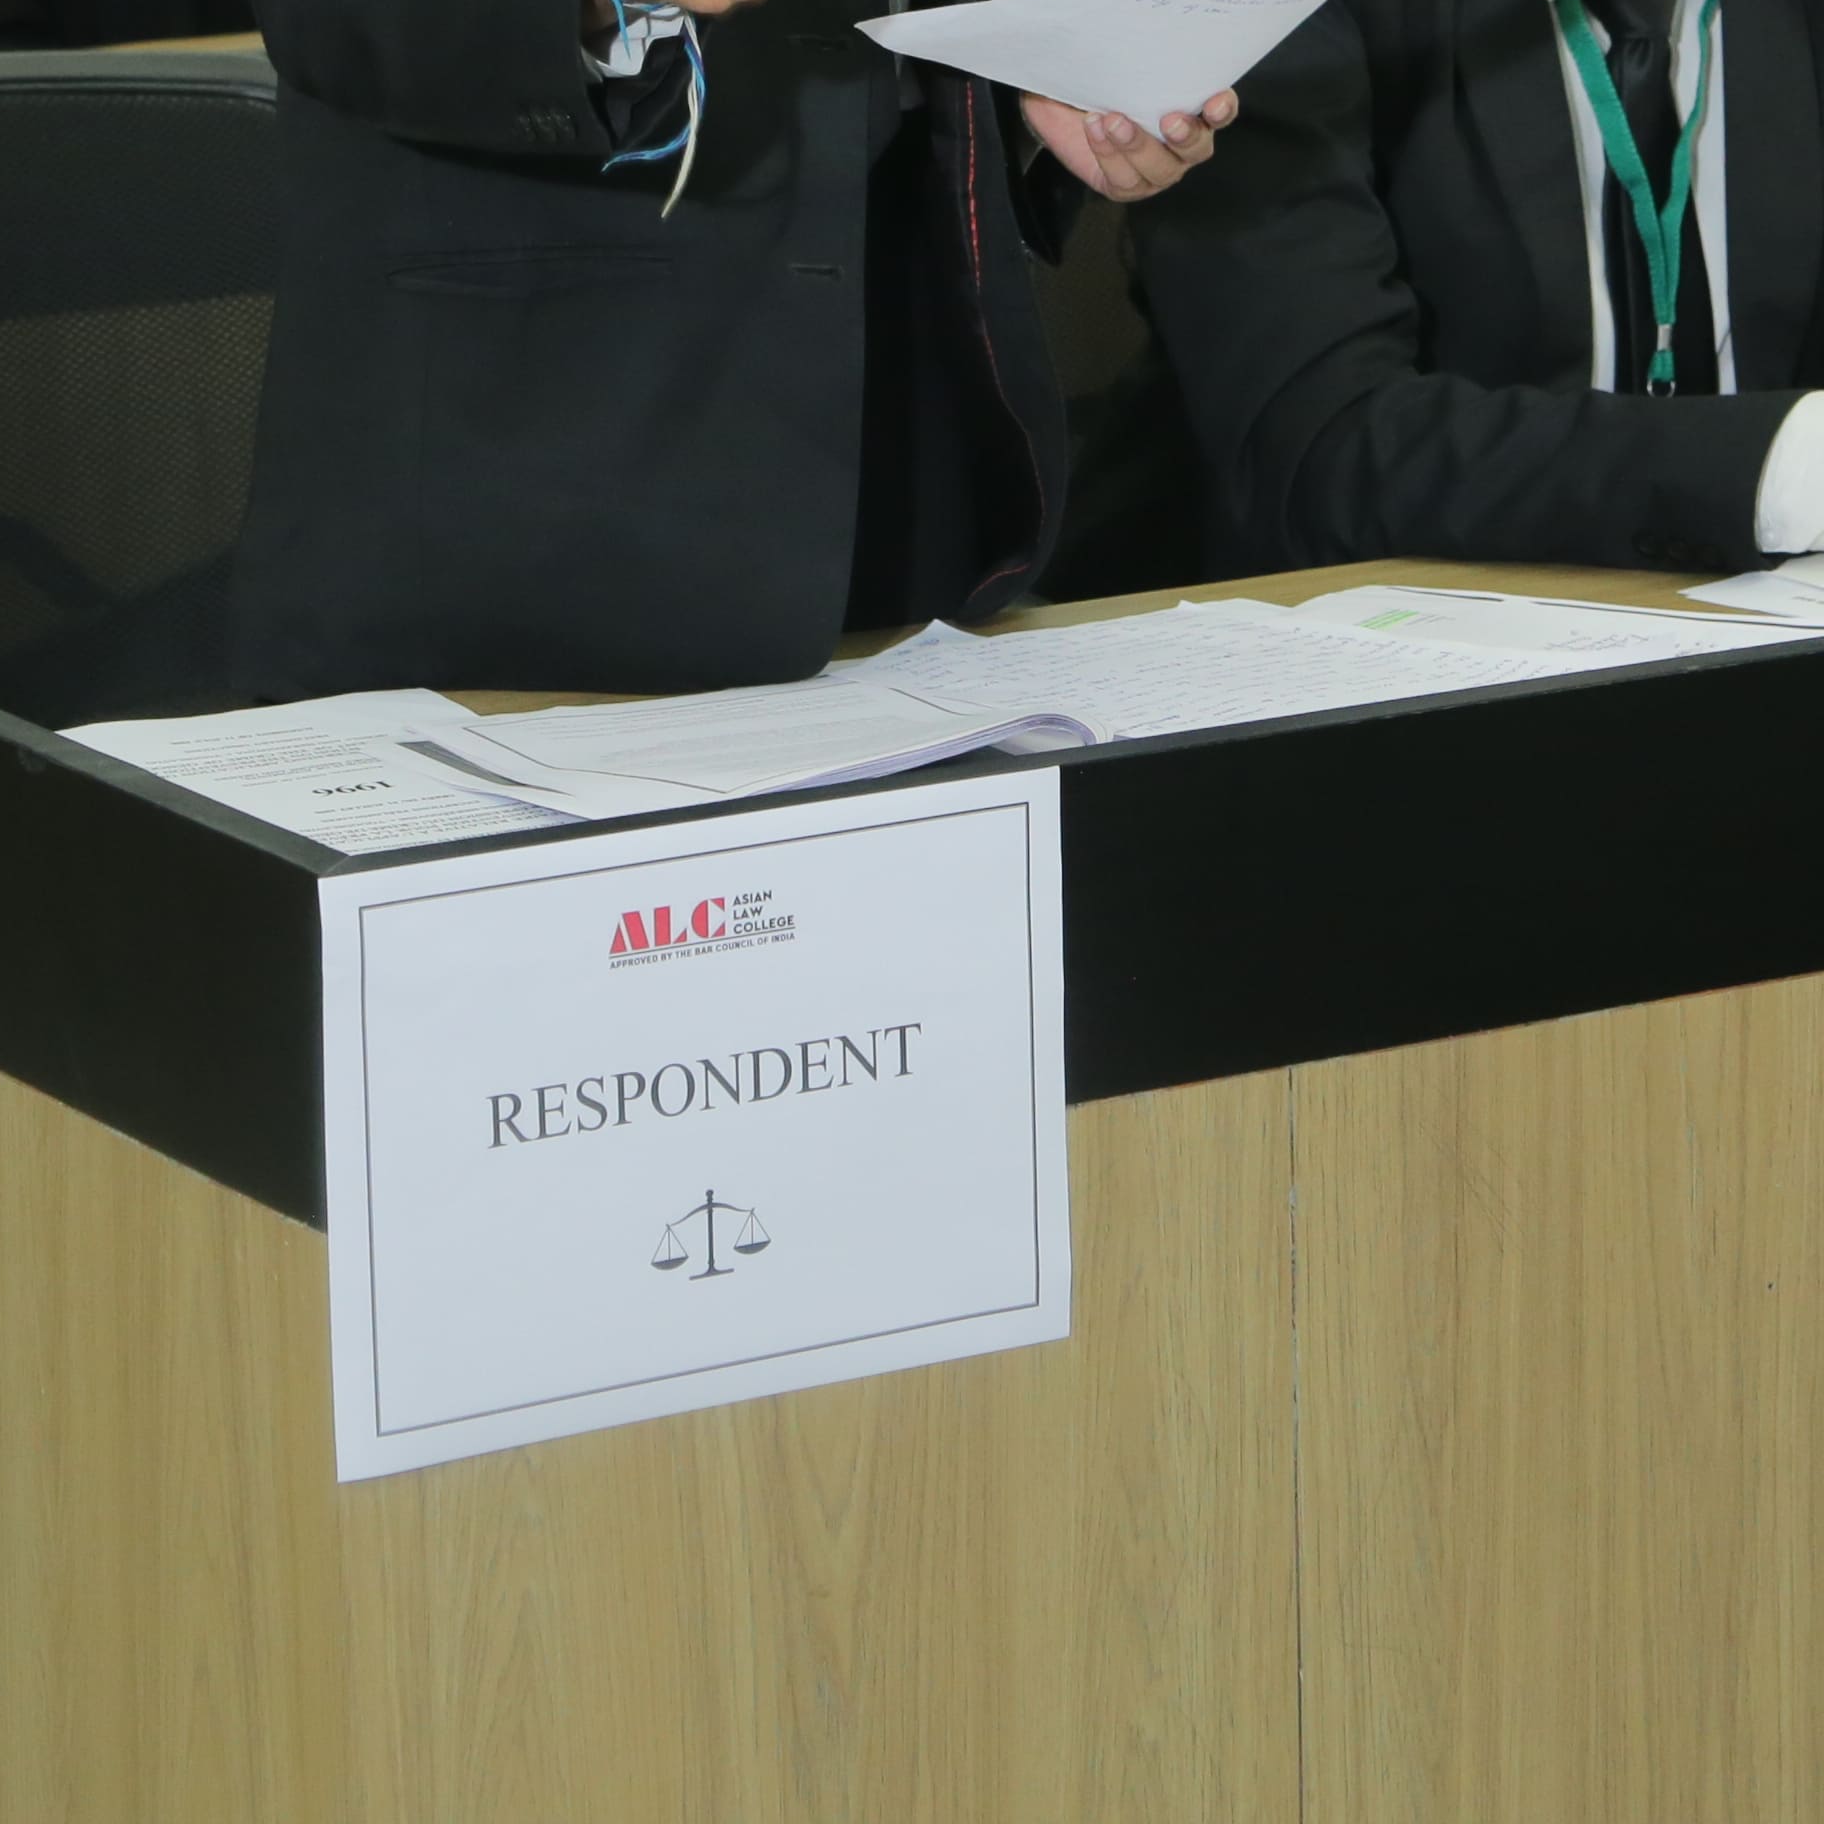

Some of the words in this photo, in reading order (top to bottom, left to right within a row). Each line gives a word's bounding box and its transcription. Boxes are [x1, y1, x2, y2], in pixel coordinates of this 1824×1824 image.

[311, 780, 393, 798] 1996
[733, 889, 773, 906] ASIAN
[733, 905, 764, 921] LAW
[609, 896, 726, 954] ALC
[733, 915, 795, 935] COLLEGE
[609, 954, 659, 970] APPROVED
[660, 952, 673, 962] BY
[675, 949, 692, 959] THE
[695, 946, 714, 956] BAR
[715, 939, 755, 953] COUNCIL
[757, 936, 769, 946] OF
[771, 932, 796, 944] INDIA
[485, 1022, 924, 1150] RESPONDENT
